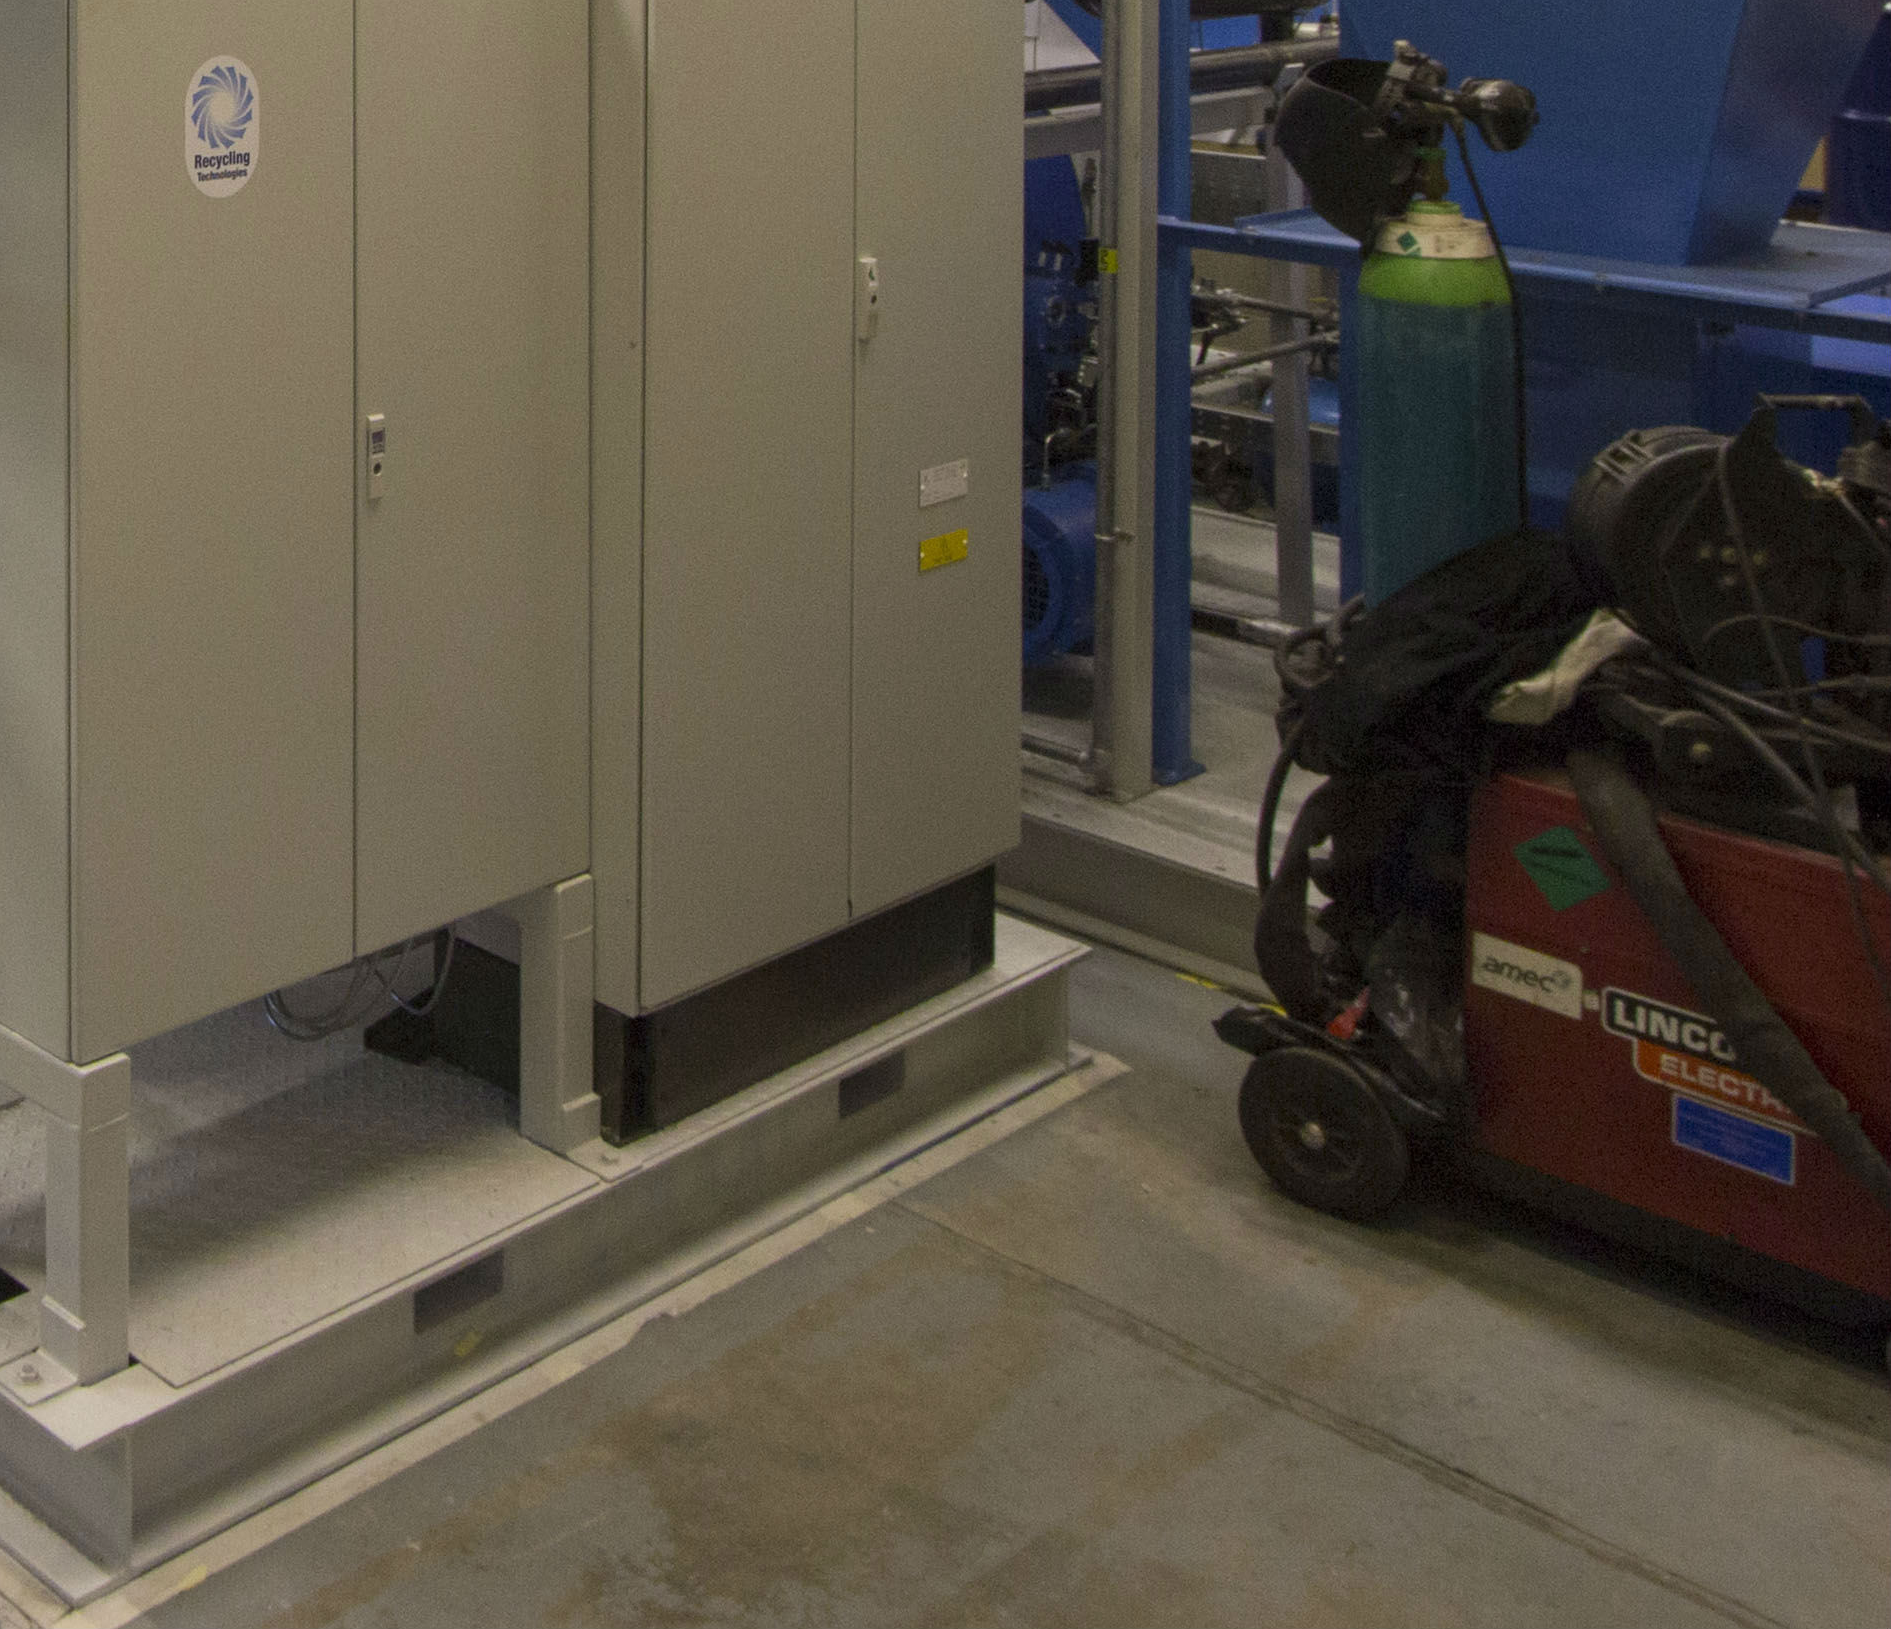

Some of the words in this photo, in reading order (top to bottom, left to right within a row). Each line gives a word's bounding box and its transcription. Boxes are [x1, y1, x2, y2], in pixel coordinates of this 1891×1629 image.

[194, 151, 250, 169] Recycling
[197, 168, 248, 182] Technologies
[1481, 955, 1556, 994] amec
